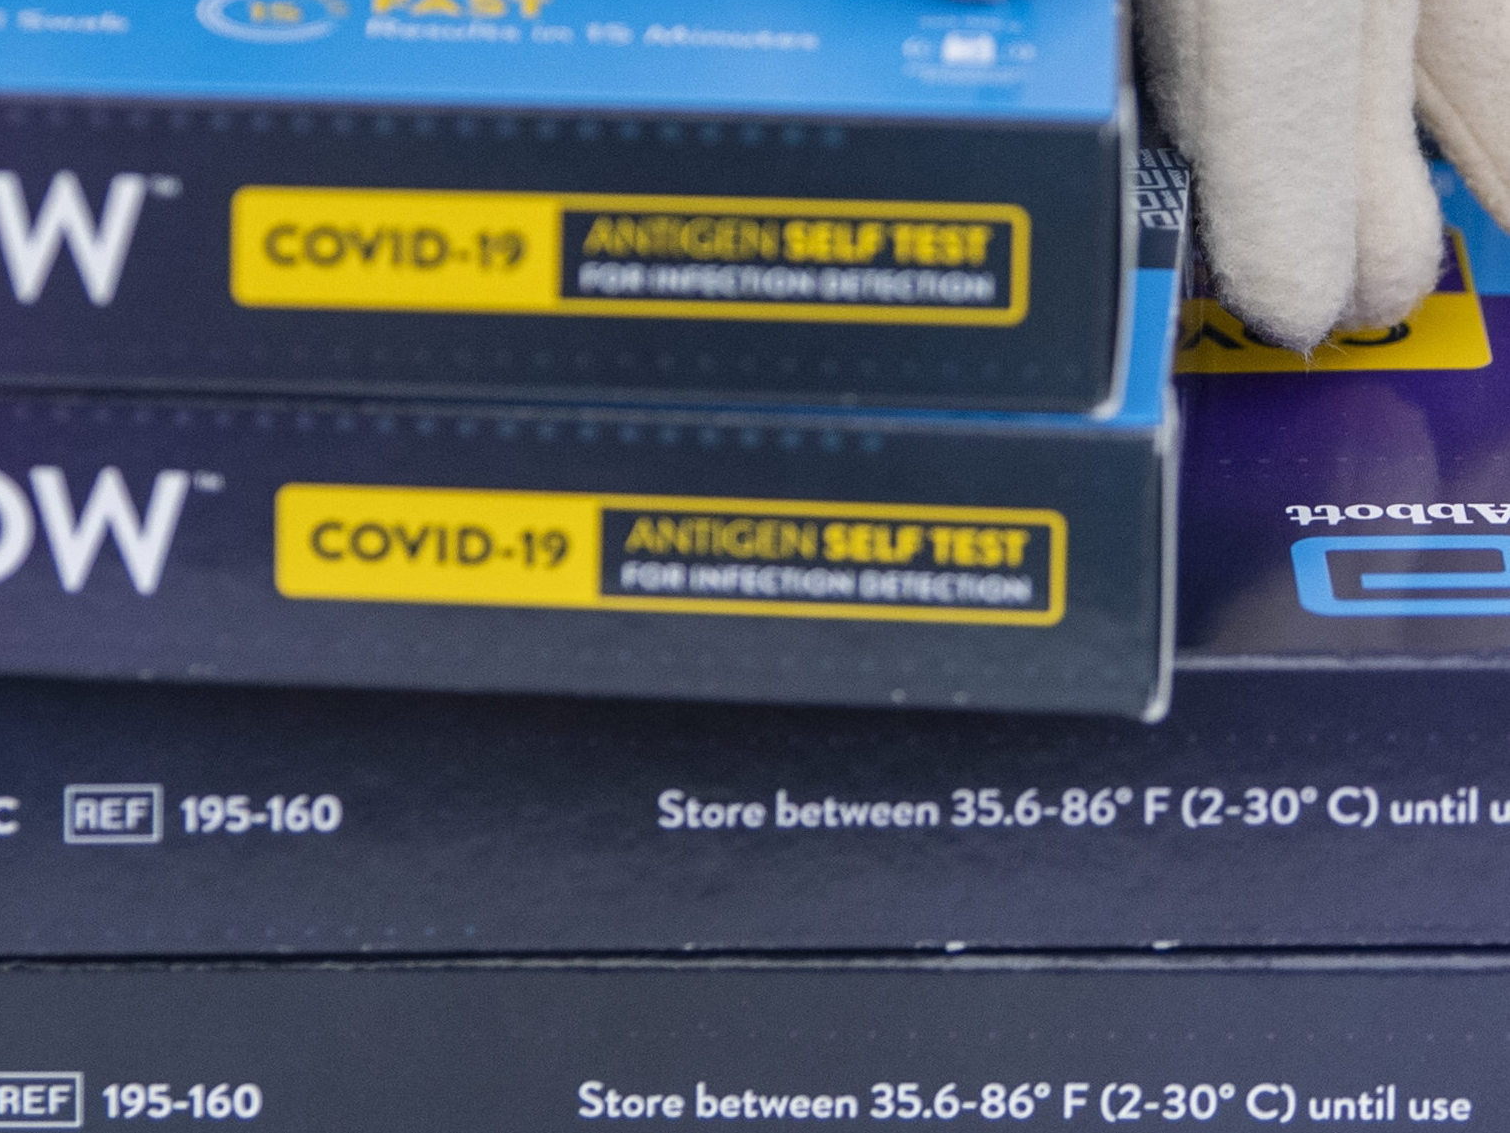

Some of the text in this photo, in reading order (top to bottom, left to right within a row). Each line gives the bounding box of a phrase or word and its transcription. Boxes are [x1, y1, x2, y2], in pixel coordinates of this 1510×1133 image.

[261, 222, 530, 273] COVID-19
[583, 215, 993, 267] ANTIGEN SELF TEST
[308, 519, 572, 570] COVID-19
[625, 516, 1031, 569] ANTIGEN SELF TEST
[77, 794, 343, 834] REF 195-160
[657, 788, 767, 829] Store
[774, 789, 941, 829] between
[950, 786, 1134, 828] 35.6-86°
[1143, 786, 1172, 826] F
[1180, 786, 1319, 829] (2-30°
[1326, 785, 1380, 829] C)
[1389, 786, 1479, 825] until
[102, 1082, 263, 1120] 195-160
[577, 1080, 1473, 1125] Store between 35.6-86° F (2-30° C) until use
